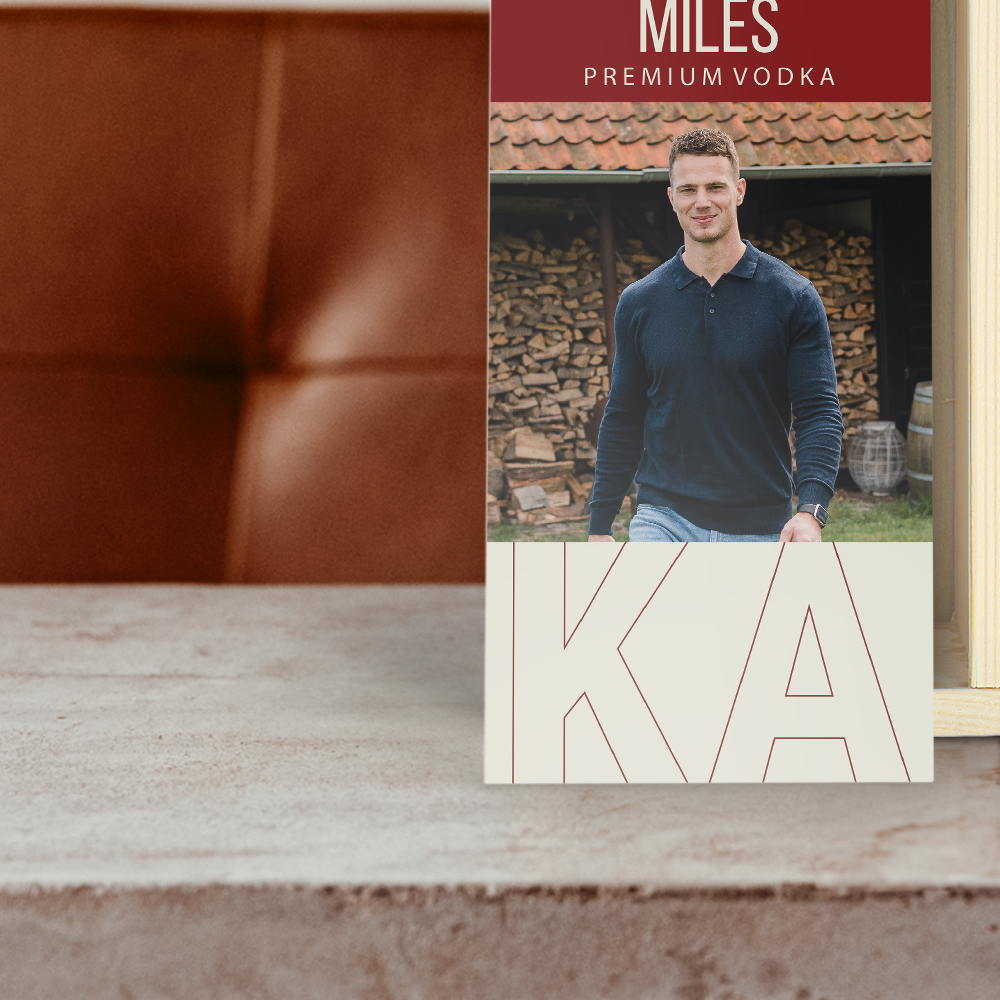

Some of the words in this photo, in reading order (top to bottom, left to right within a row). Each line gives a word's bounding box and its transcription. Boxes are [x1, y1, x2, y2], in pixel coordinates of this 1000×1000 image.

[584, 67, 722, 86] PREMIUM
[733, 66, 835, 86] VODKA
[511, 541, 912, 783] KA
